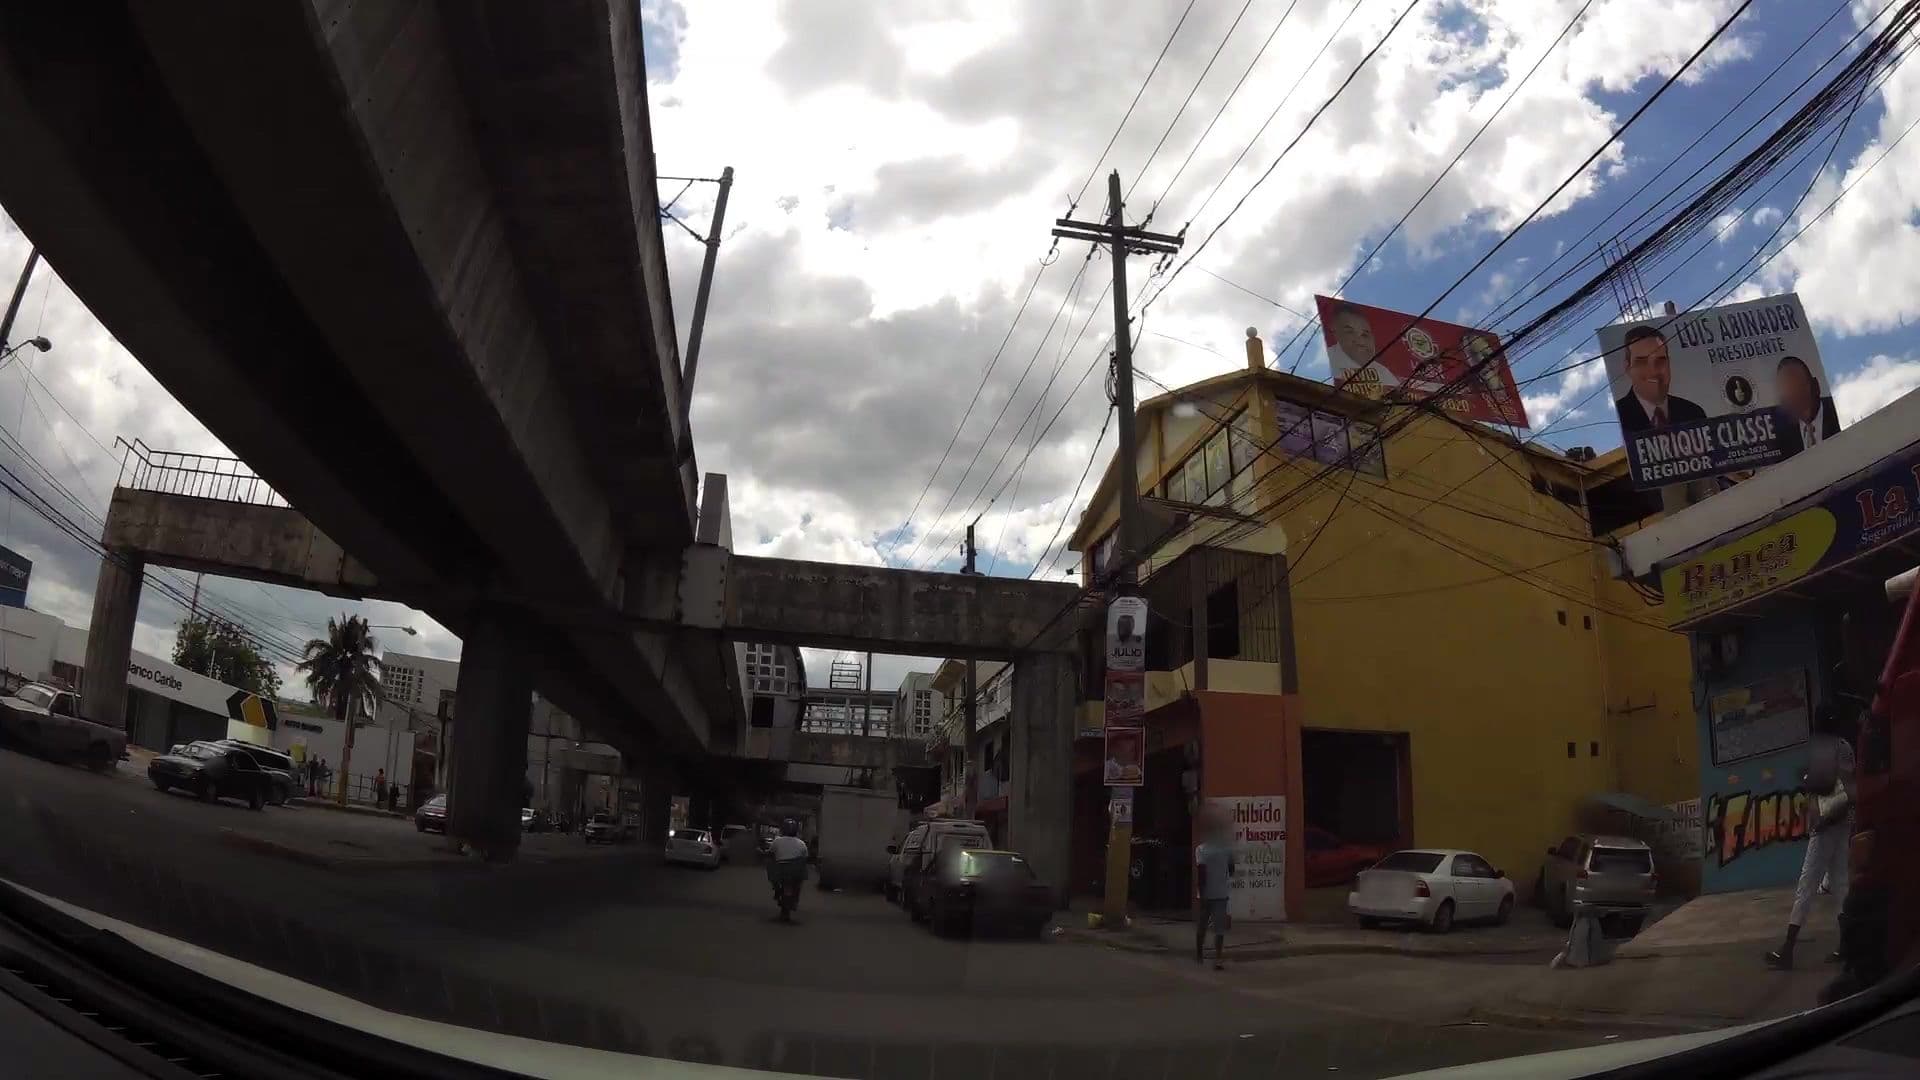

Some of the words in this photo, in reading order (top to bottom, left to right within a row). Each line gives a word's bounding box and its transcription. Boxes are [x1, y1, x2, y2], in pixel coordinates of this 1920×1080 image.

[1675, 317, 1715, 349] LUIS
[1718, 303, 1800, 341] ABINADER
[1707, 336, 1786, 365] PRESIDENTE
[1635, 424, 1714, 464] ENRIQUE
[1716, 413, 1777, 449] CLASSE
[1641, 455, 1713, 483] REGIDOR
[1111, 647, 1143, 657] JULIO
[154, 670, 182, 690] Caribe
[1245, 827, 1288, 841] basura
